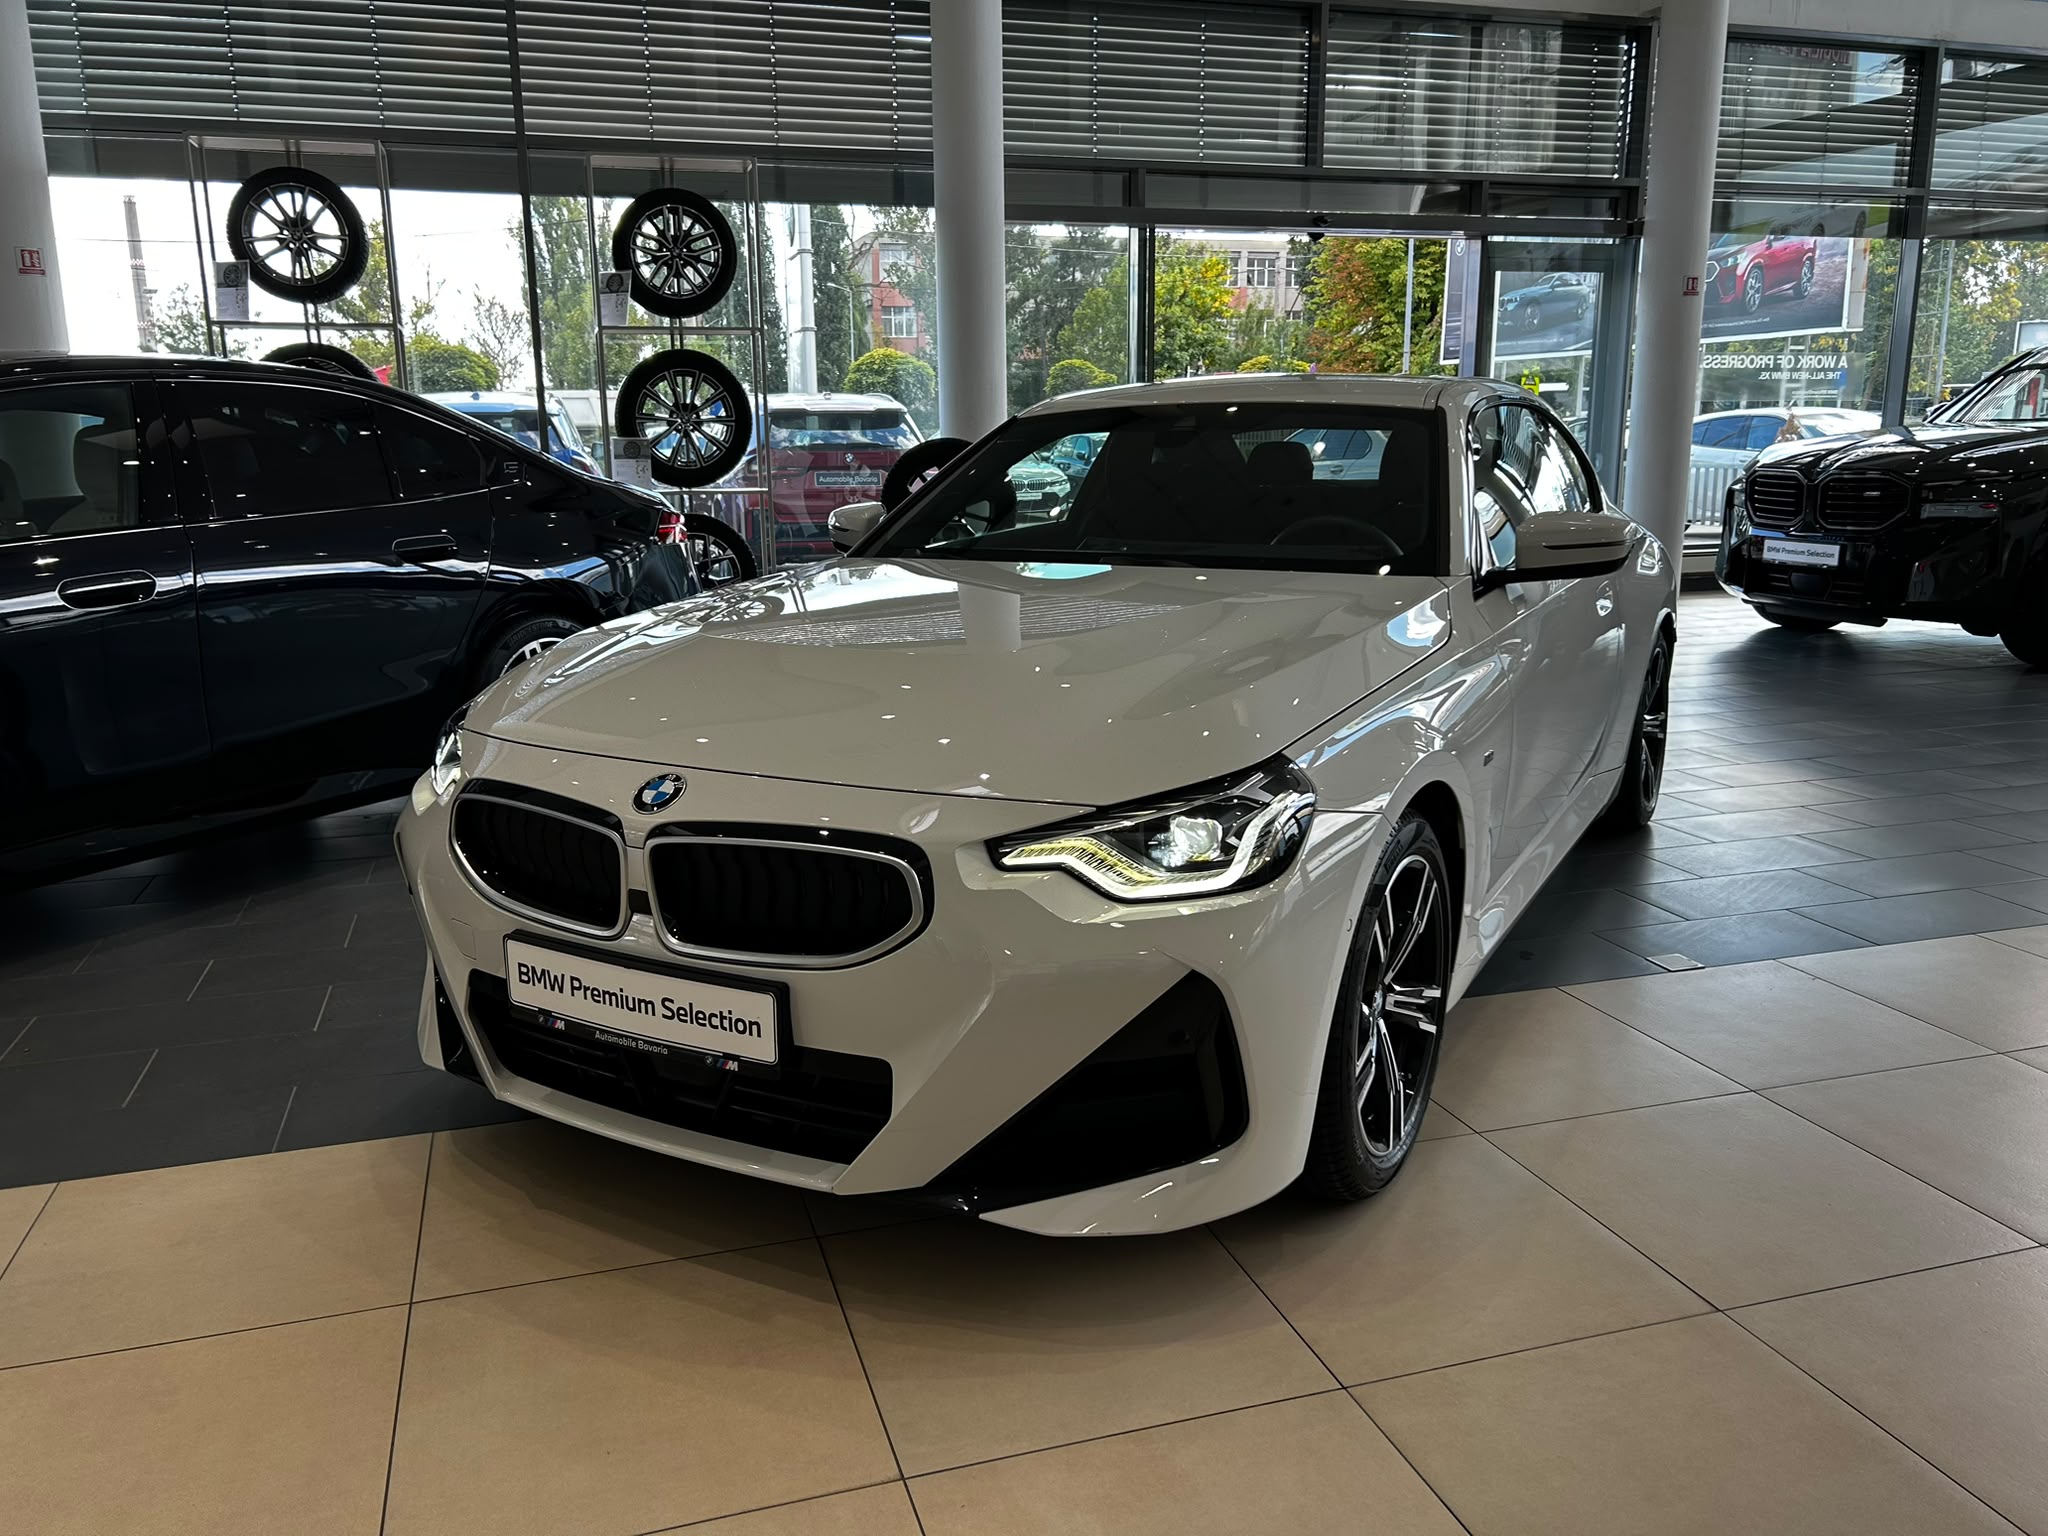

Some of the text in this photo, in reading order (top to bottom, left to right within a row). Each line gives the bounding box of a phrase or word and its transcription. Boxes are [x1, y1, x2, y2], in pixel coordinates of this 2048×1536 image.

[819, 475, 878, 483] Automobile Bavaria
[1766, 545, 1835, 559] BMW Premium Selection
[517, 961, 762, 1038] BMW Premium Selection
[594, 1030, 668, 1055] Automobile Bavaria
